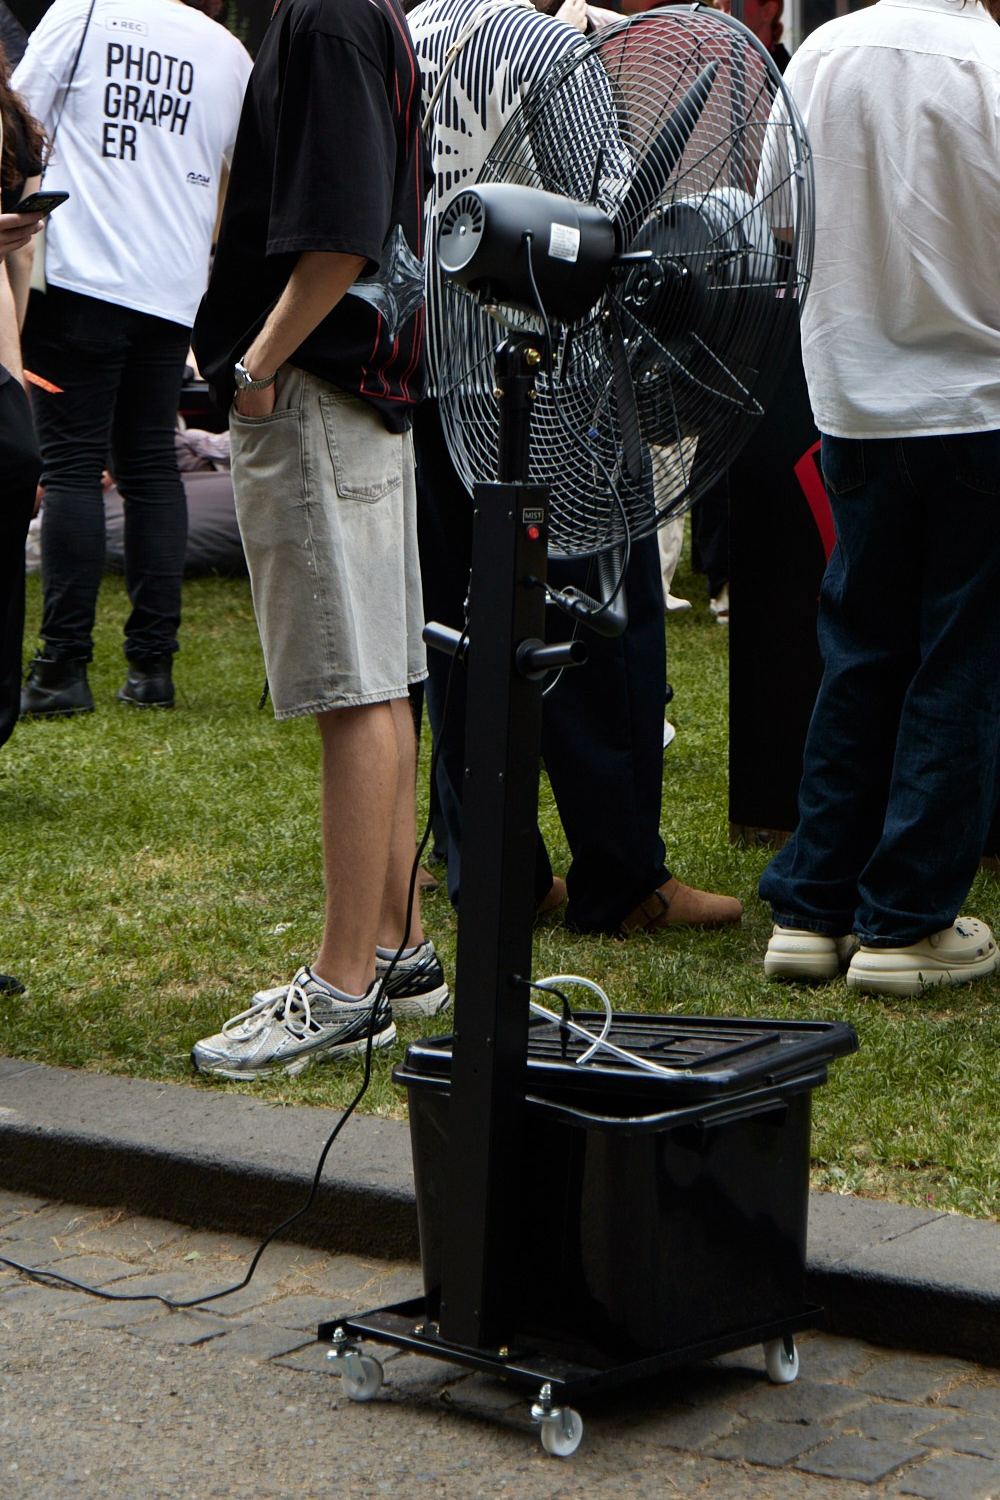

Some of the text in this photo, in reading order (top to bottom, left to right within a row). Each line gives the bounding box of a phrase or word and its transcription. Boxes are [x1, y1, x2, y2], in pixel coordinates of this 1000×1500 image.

[121, 21, 143, 32] REC
[106, 42, 194, 95] PHOTO
[104, 82, 191, 136] GRAPH
[101, 122, 137, 161] ER
[524, 512, 541, 520] MIST
